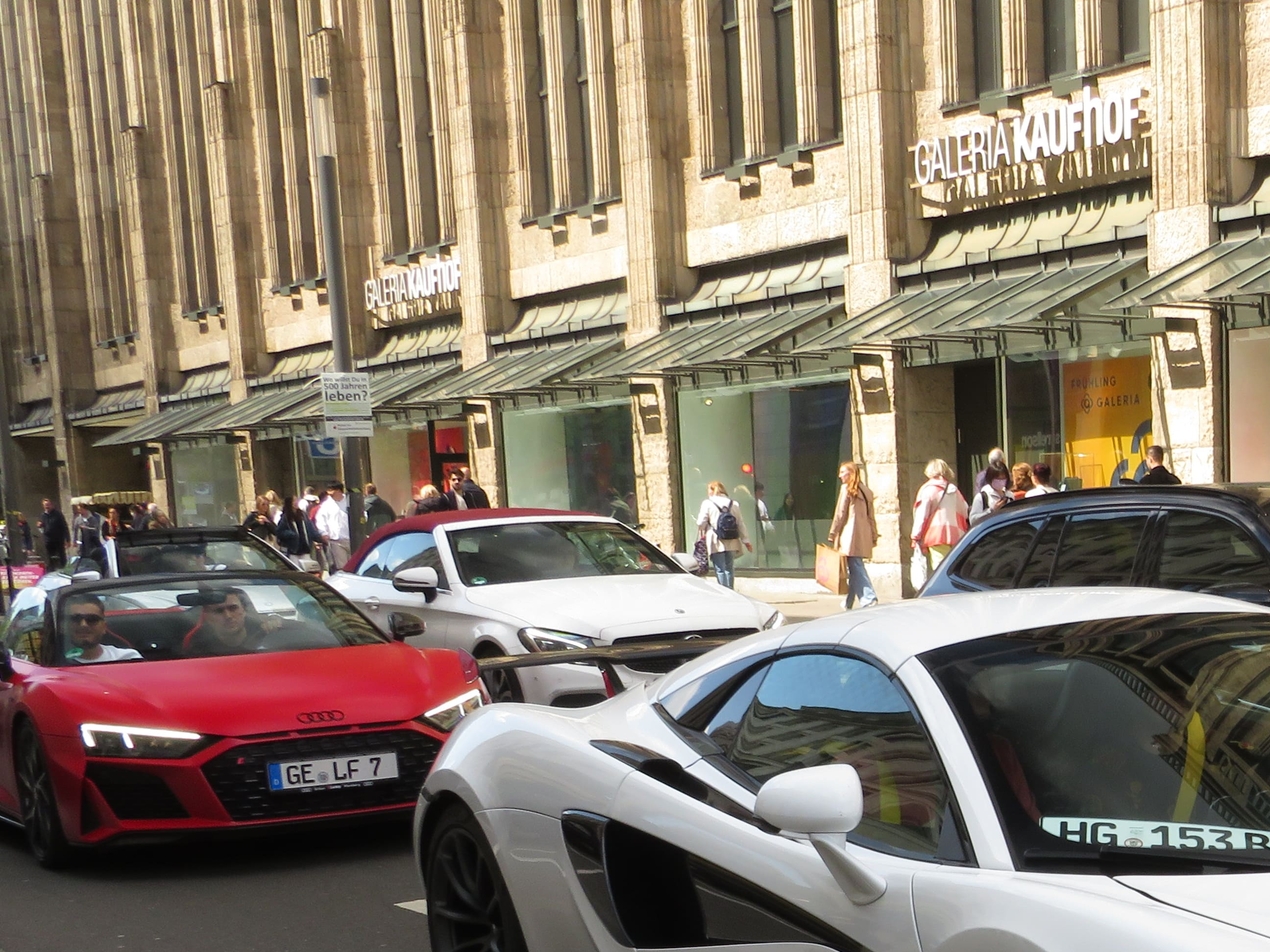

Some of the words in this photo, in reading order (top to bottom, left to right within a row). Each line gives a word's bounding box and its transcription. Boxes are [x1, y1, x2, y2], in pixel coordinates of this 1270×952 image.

[915, 120, 1011, 185] GALERIA
[364, 272, 408, 311] GALERIA
[325, 390, 368, 402] leben?
[1096, 393, 1140, 408] GALERIA
[286, 764, 315, 785] GE
[333, 759, 360, 781] LF
[369, 757, 382, 777] 7
[1060, 821, 1118, 847] HG
[1151, 826, 1233, 850] 153
